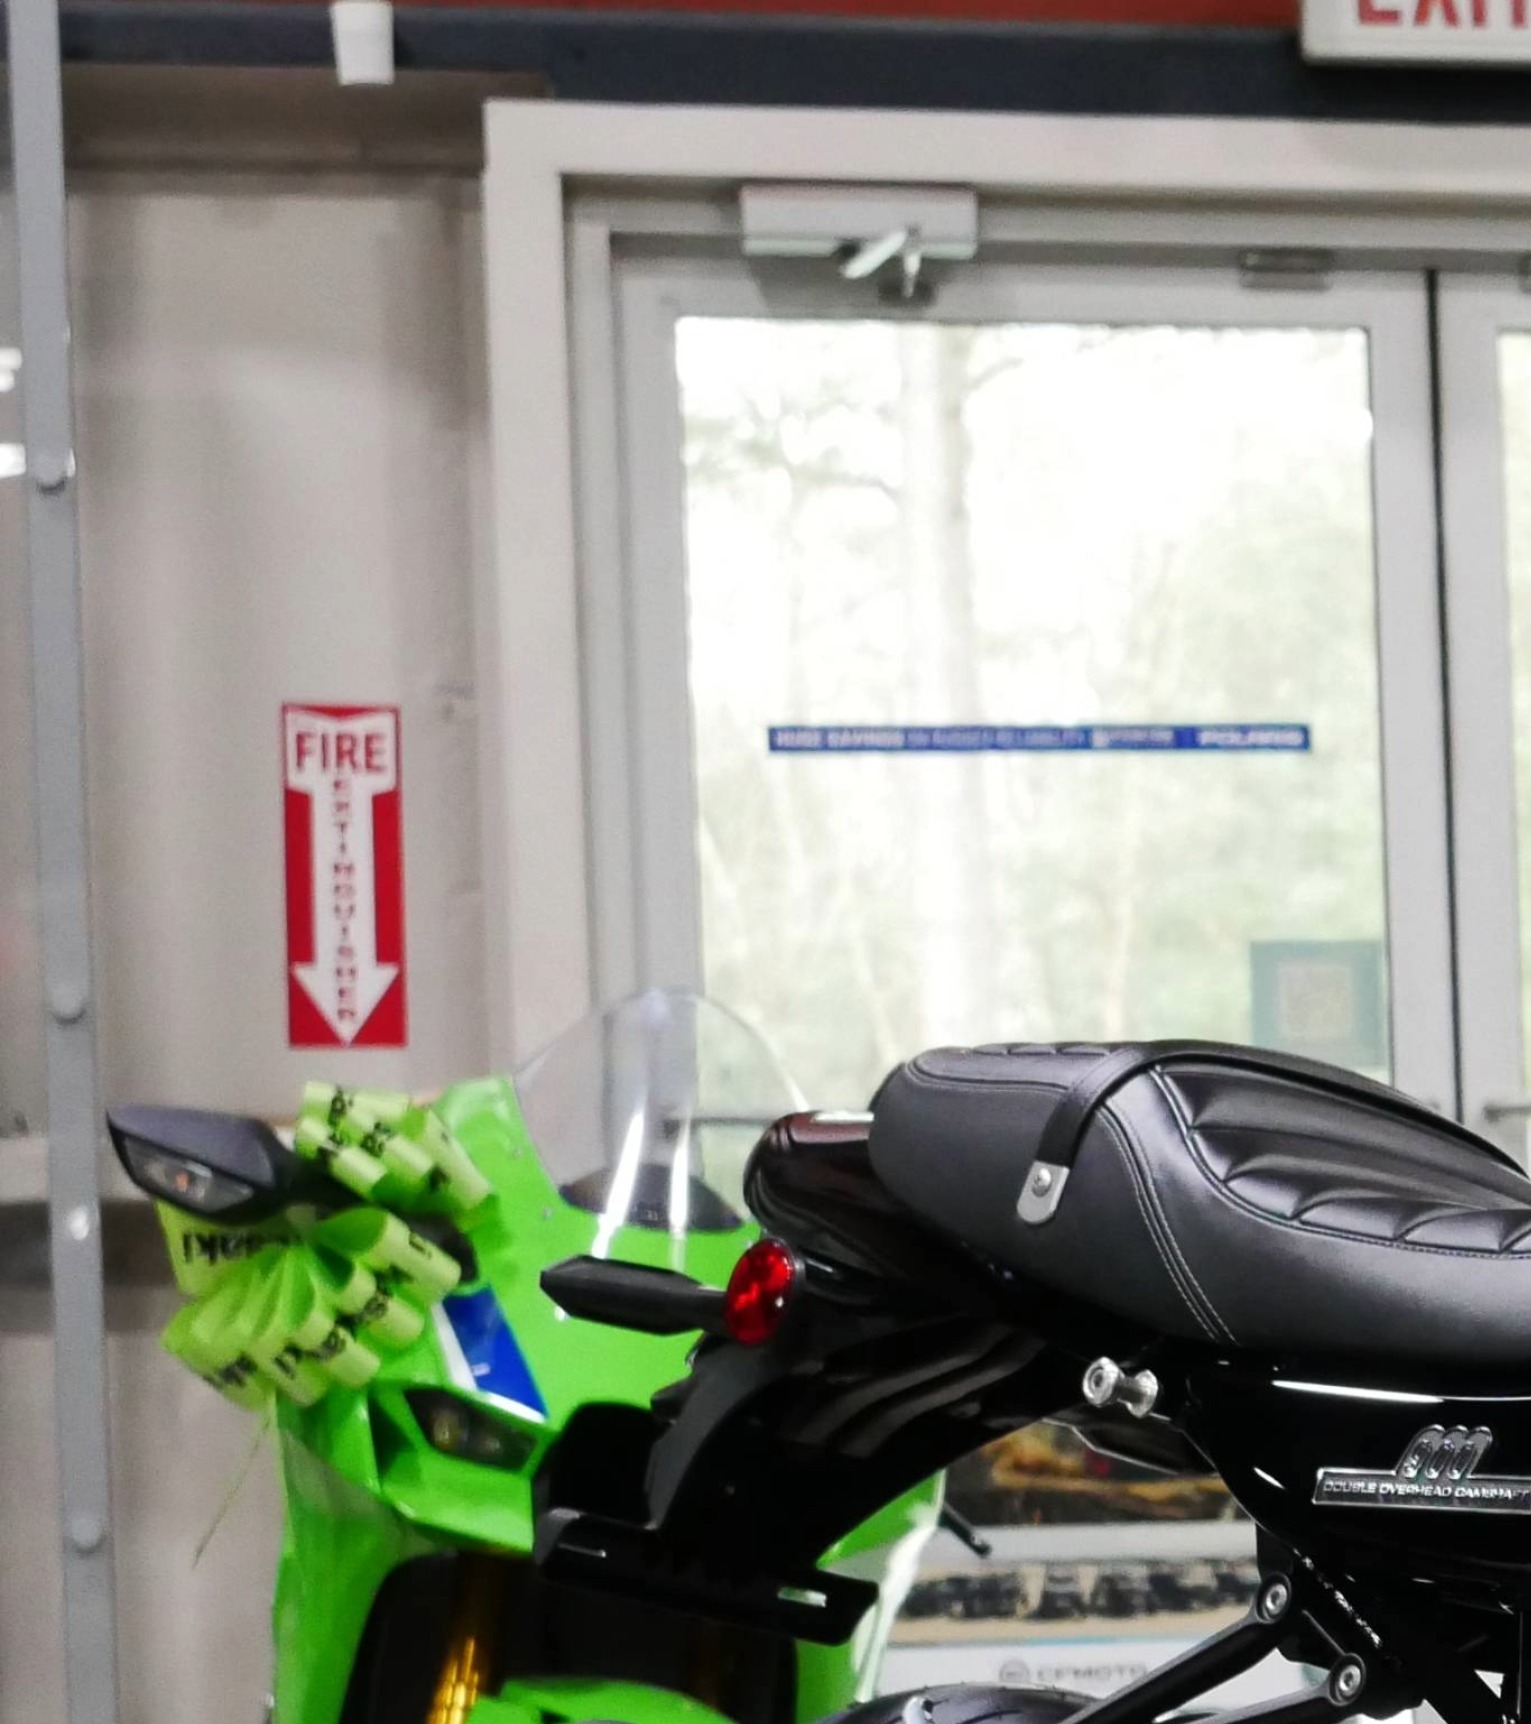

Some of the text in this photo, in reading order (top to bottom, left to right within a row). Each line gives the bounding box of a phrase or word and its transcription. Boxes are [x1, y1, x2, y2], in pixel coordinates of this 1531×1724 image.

[295, 732, 387, 773] FIRE
[1323, 1480, 1377, 1495] DOUBLE
[1379, 1482, 1453, 1497] OVERHEAD
